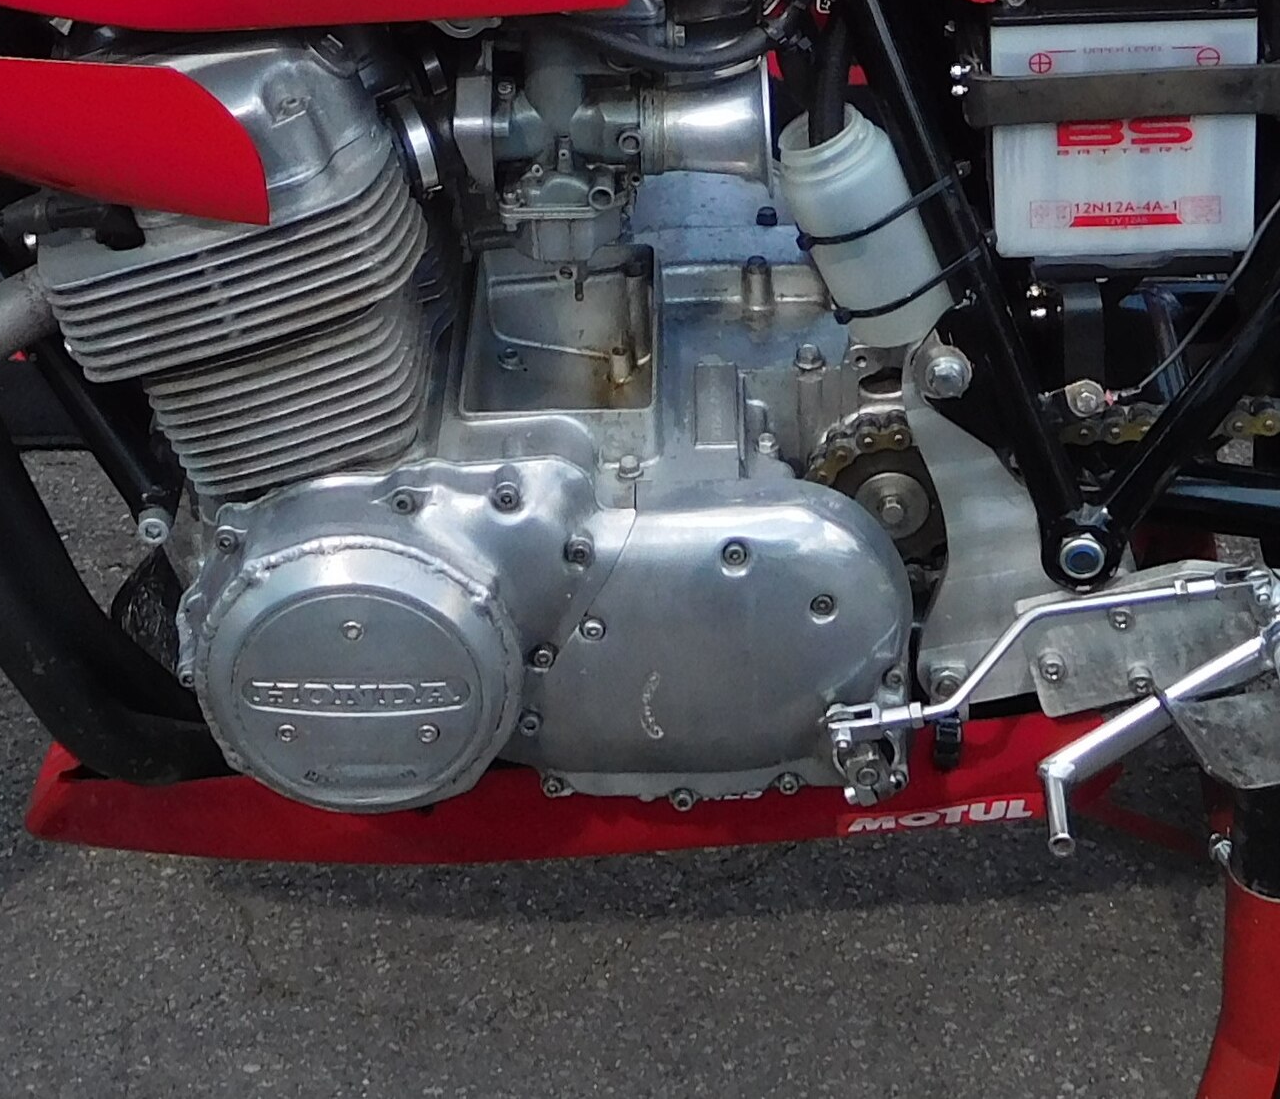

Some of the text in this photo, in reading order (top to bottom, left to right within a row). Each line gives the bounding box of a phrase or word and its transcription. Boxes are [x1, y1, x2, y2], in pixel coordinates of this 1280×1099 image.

[1056, 115, 1193, 147] BS
[252, 681, 461, 705] HONDA
[848, 799, 1033, 832] MOTUL
